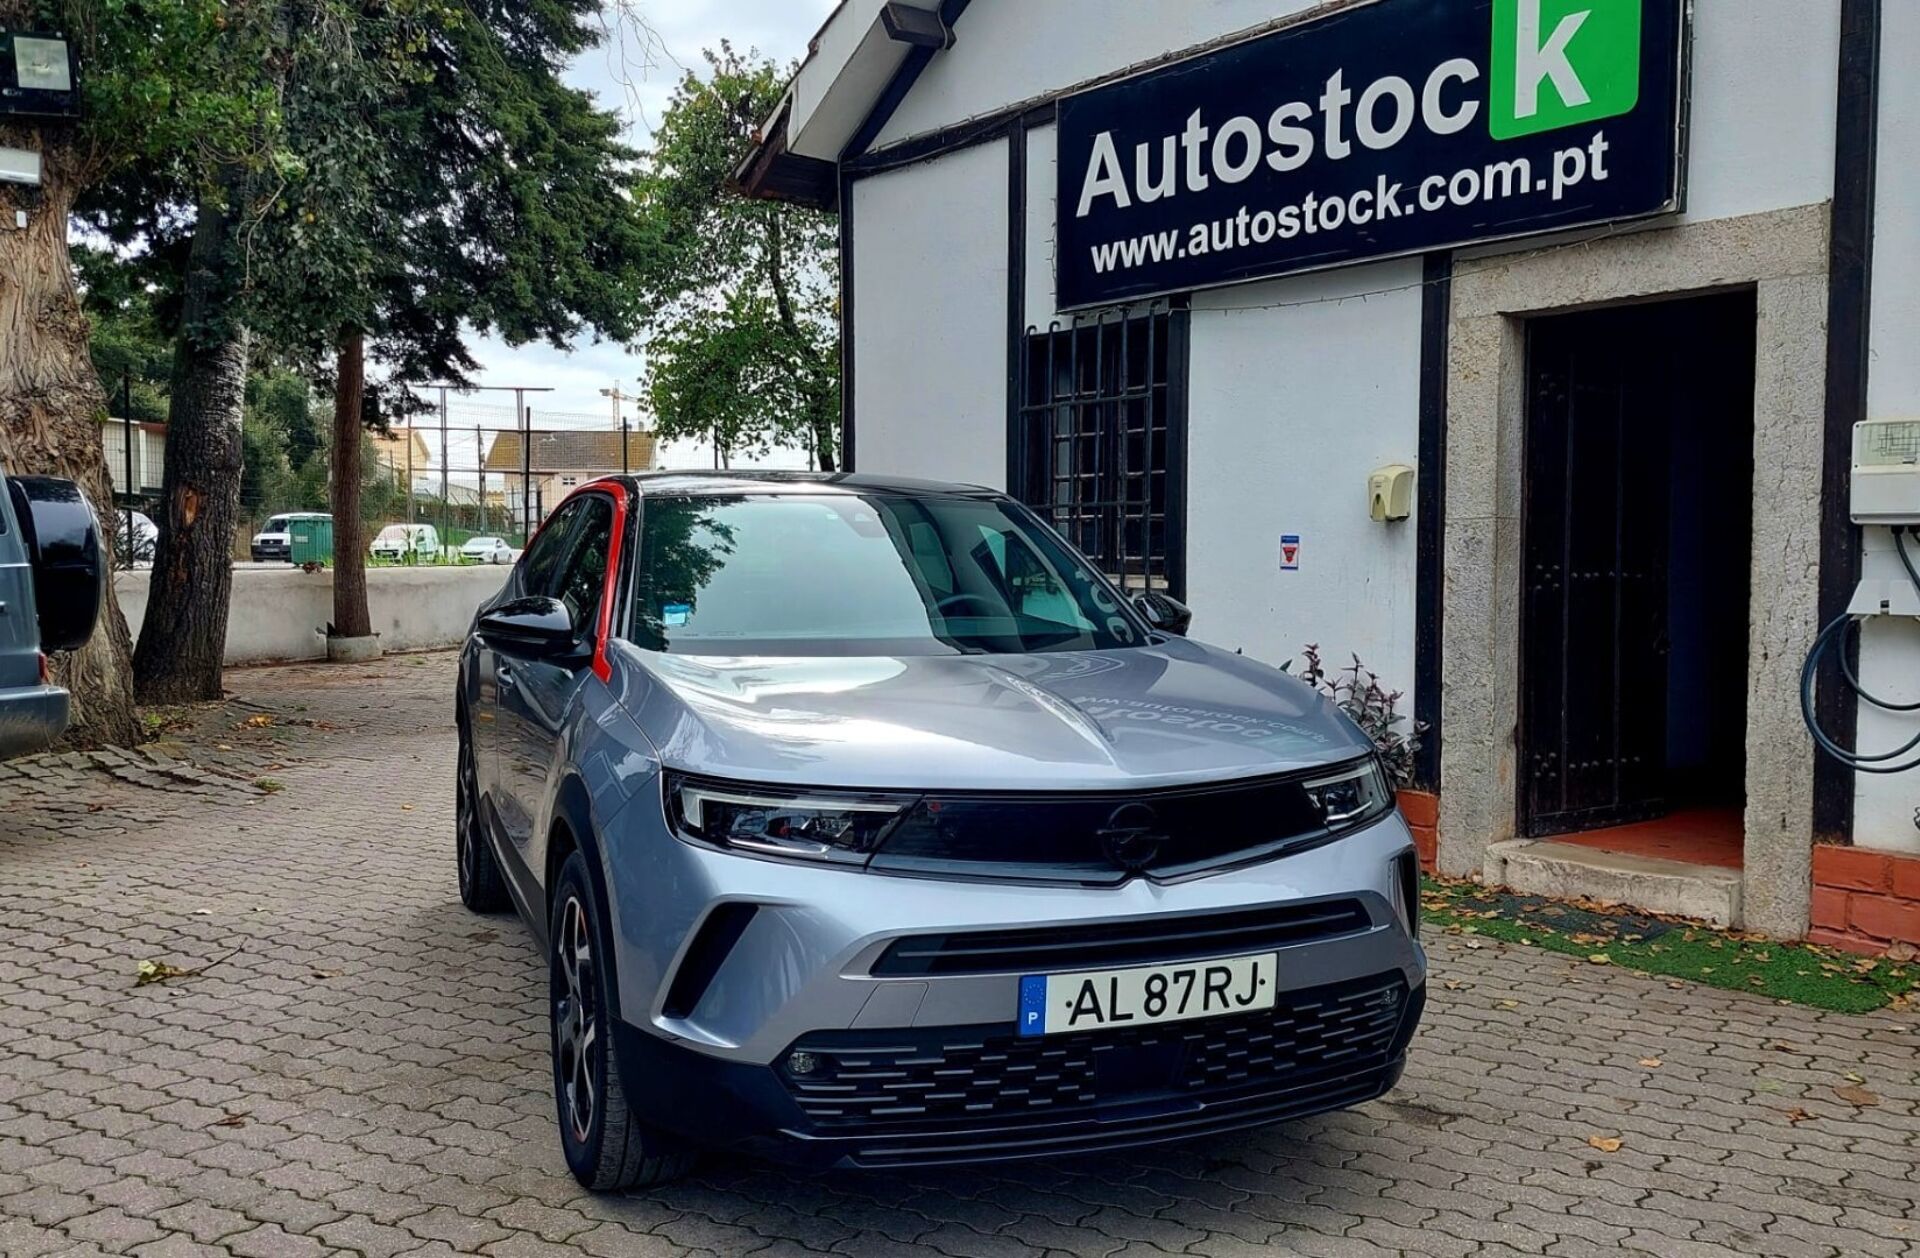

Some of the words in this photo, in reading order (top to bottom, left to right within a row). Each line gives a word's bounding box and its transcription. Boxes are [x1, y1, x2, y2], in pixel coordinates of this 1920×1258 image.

[1076, 0, 1591, 217] Autostock
[1091, 131, 1609, 273] www.autostock.com.pt
[1028, 1012, 1038, 1025] P
